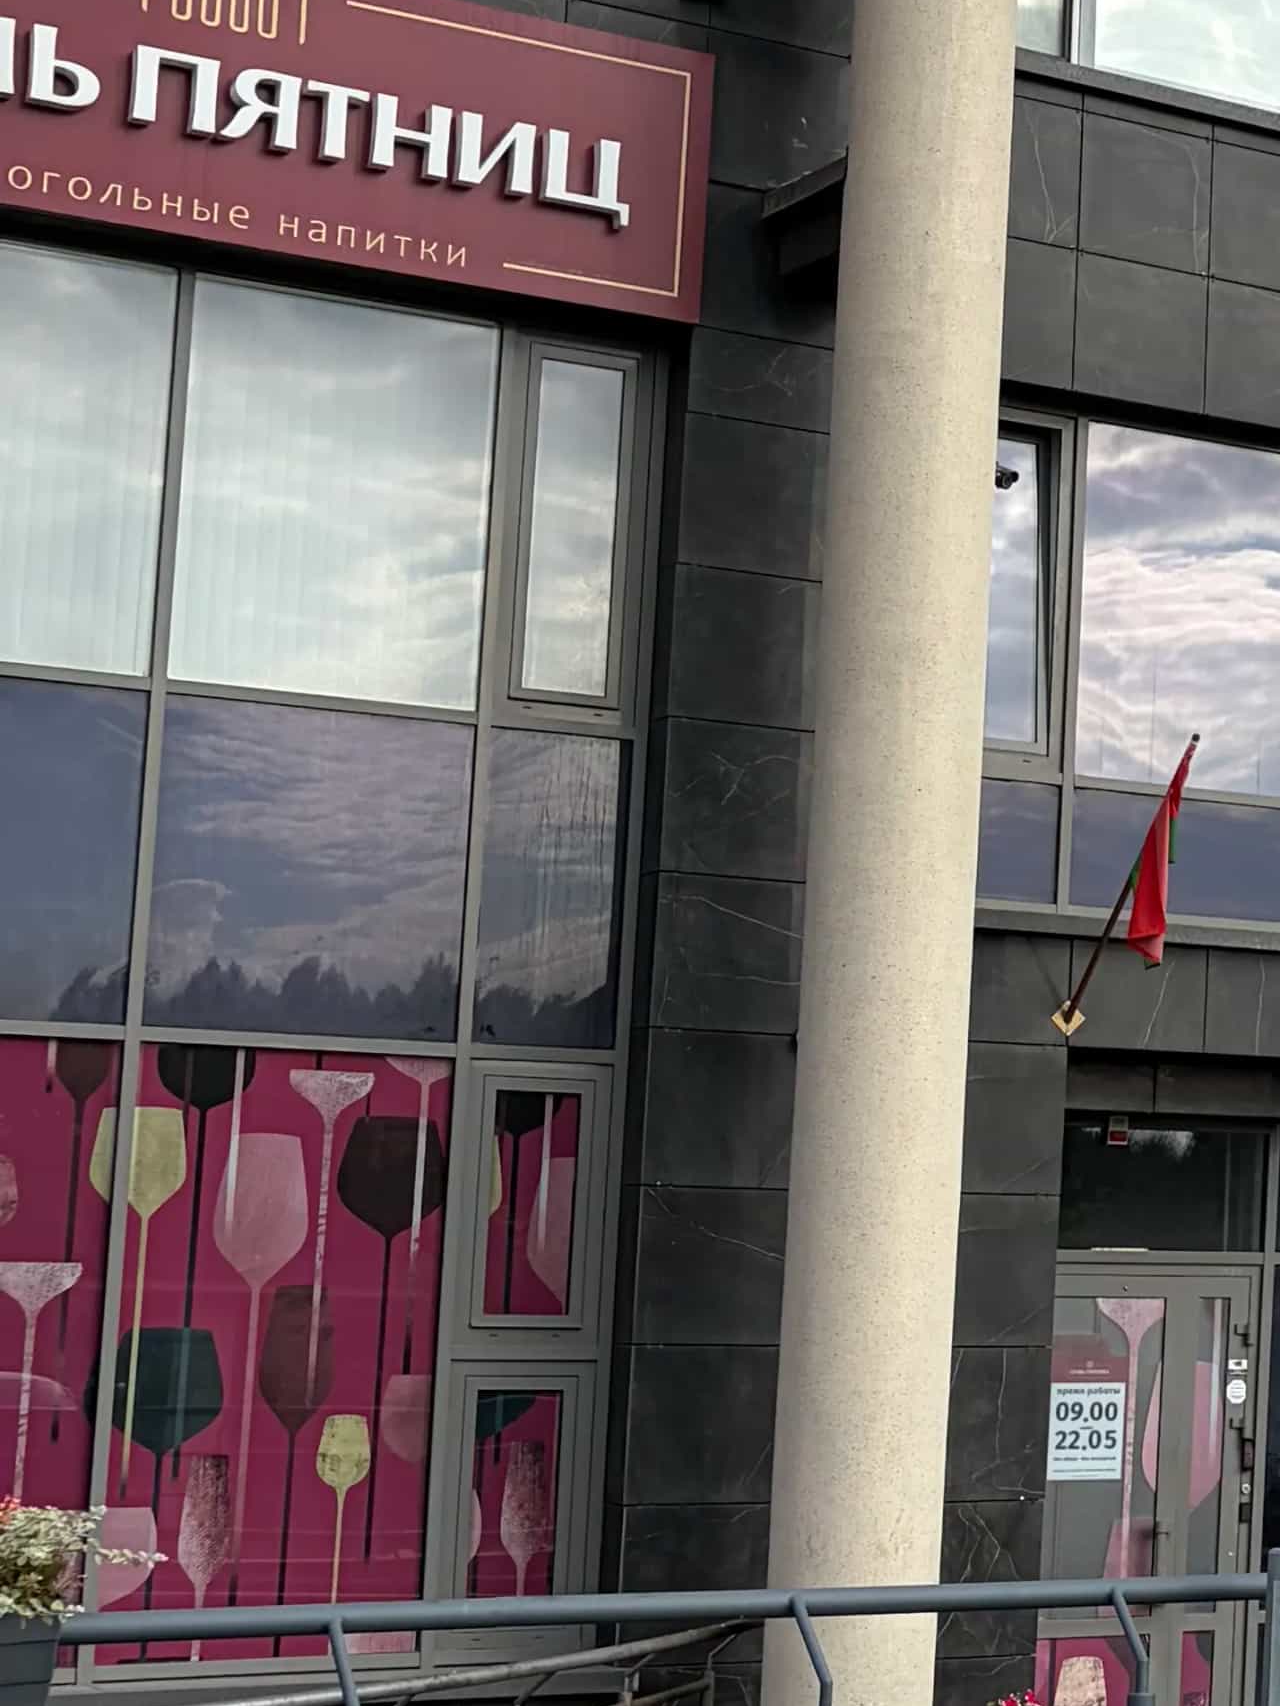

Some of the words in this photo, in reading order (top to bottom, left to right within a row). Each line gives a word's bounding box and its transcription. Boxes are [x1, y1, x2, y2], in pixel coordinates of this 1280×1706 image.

[127, 44, 630, 231] ПЯТНИЦ
[7, 165, 251, 231] огольные
[278, 213, 468, 268] напитки
[1054, 1429, 1117, 1451] 22.05
[1055, 1401, 1118, 1423] 09.00
